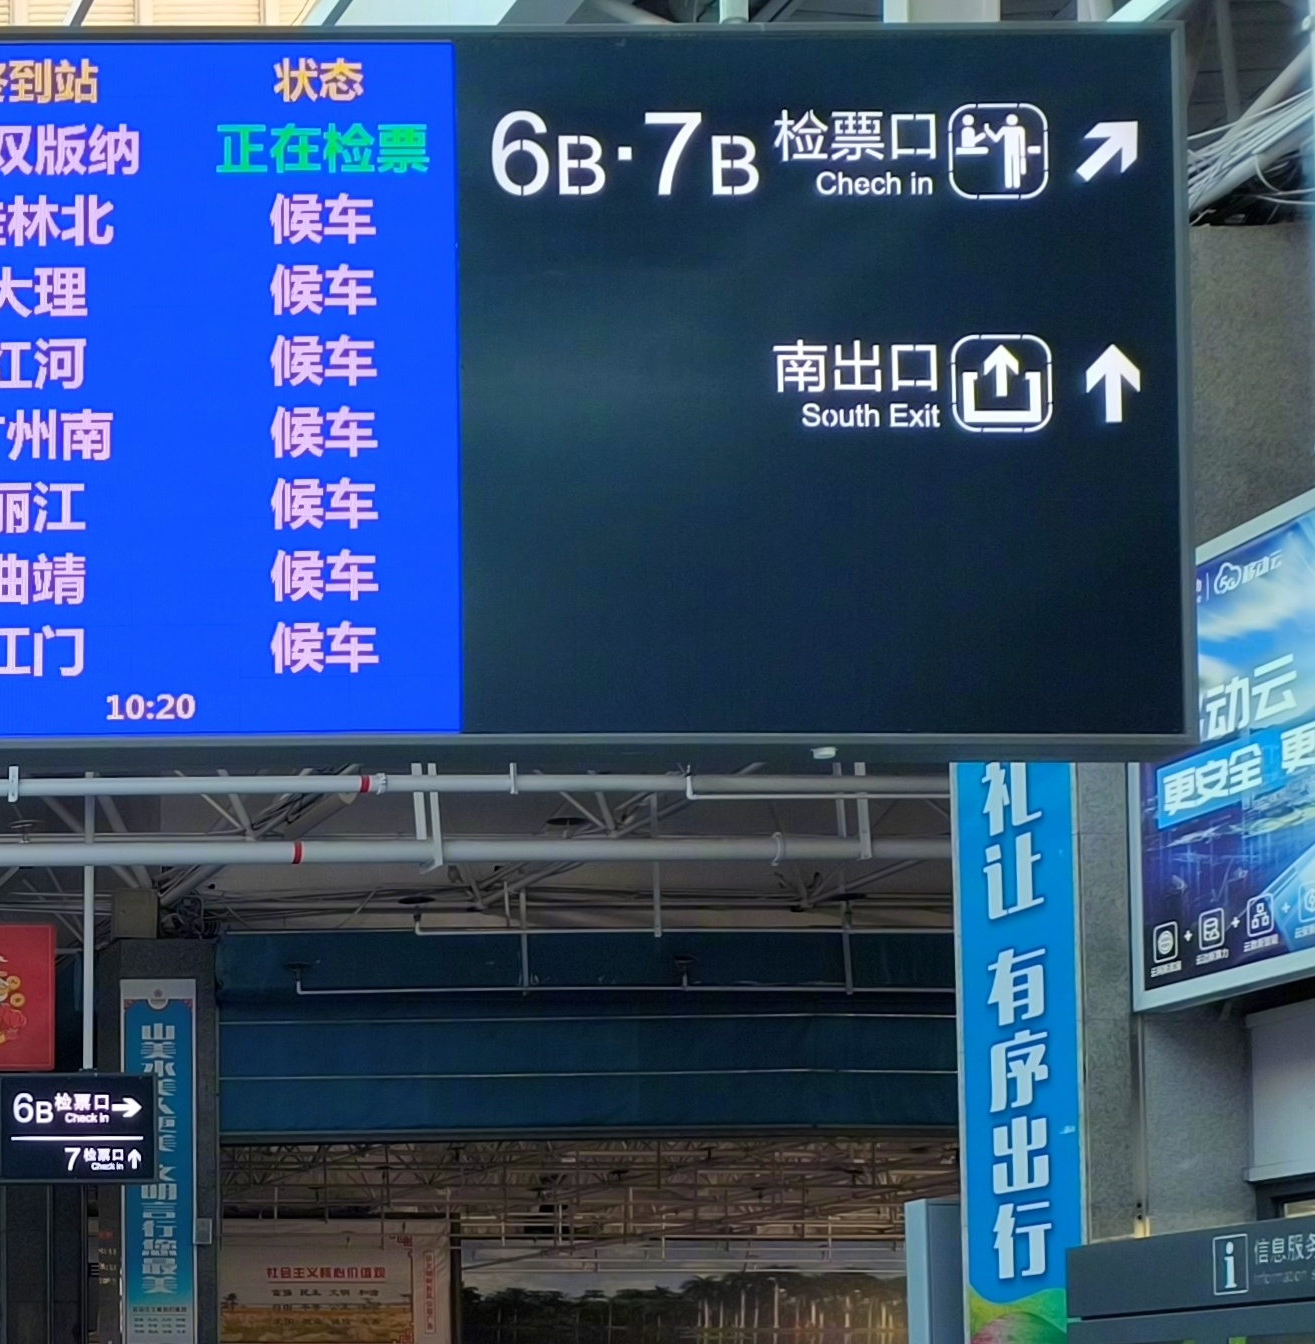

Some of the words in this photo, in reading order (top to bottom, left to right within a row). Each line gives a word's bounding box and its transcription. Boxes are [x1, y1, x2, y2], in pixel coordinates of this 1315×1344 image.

[273, 57, 364, 103] 状态
[215, 122, 431, 174] 正在检票
[774, 109, 937, 162] 检票口
[816, 171, 902, 195] Chech
[910, 171, 933, 195] in
[269, 192, 377, 245] 候车
[270, 263, 377, 316] 候车
[270, 334, 378, 387] 候车
[772, 339, 938, 393] 南出口
[270, 405, 378, 459] 候车
[802, 402, 880, 428] South
[889, 403, 941, 428] Exit
[270, 477, 379, 530] 候车
[270, 548, 379, 602] 候车
[270, 620, 379, 674] 候车
[106, 693, 196, 721] 10:20
[1163, 743, 1263, 815] 更安全
[12, 1092, 55, 1124] 6B
[55, 1092, 110, 1112] 检票口
[65, 1112, 98, 1124] Check
[99, 1112, 110, 1124] in
[986, 947, 1051, 1281] 有序出行
[266, 1267, 386, 1279] 社会主义核心价值观
